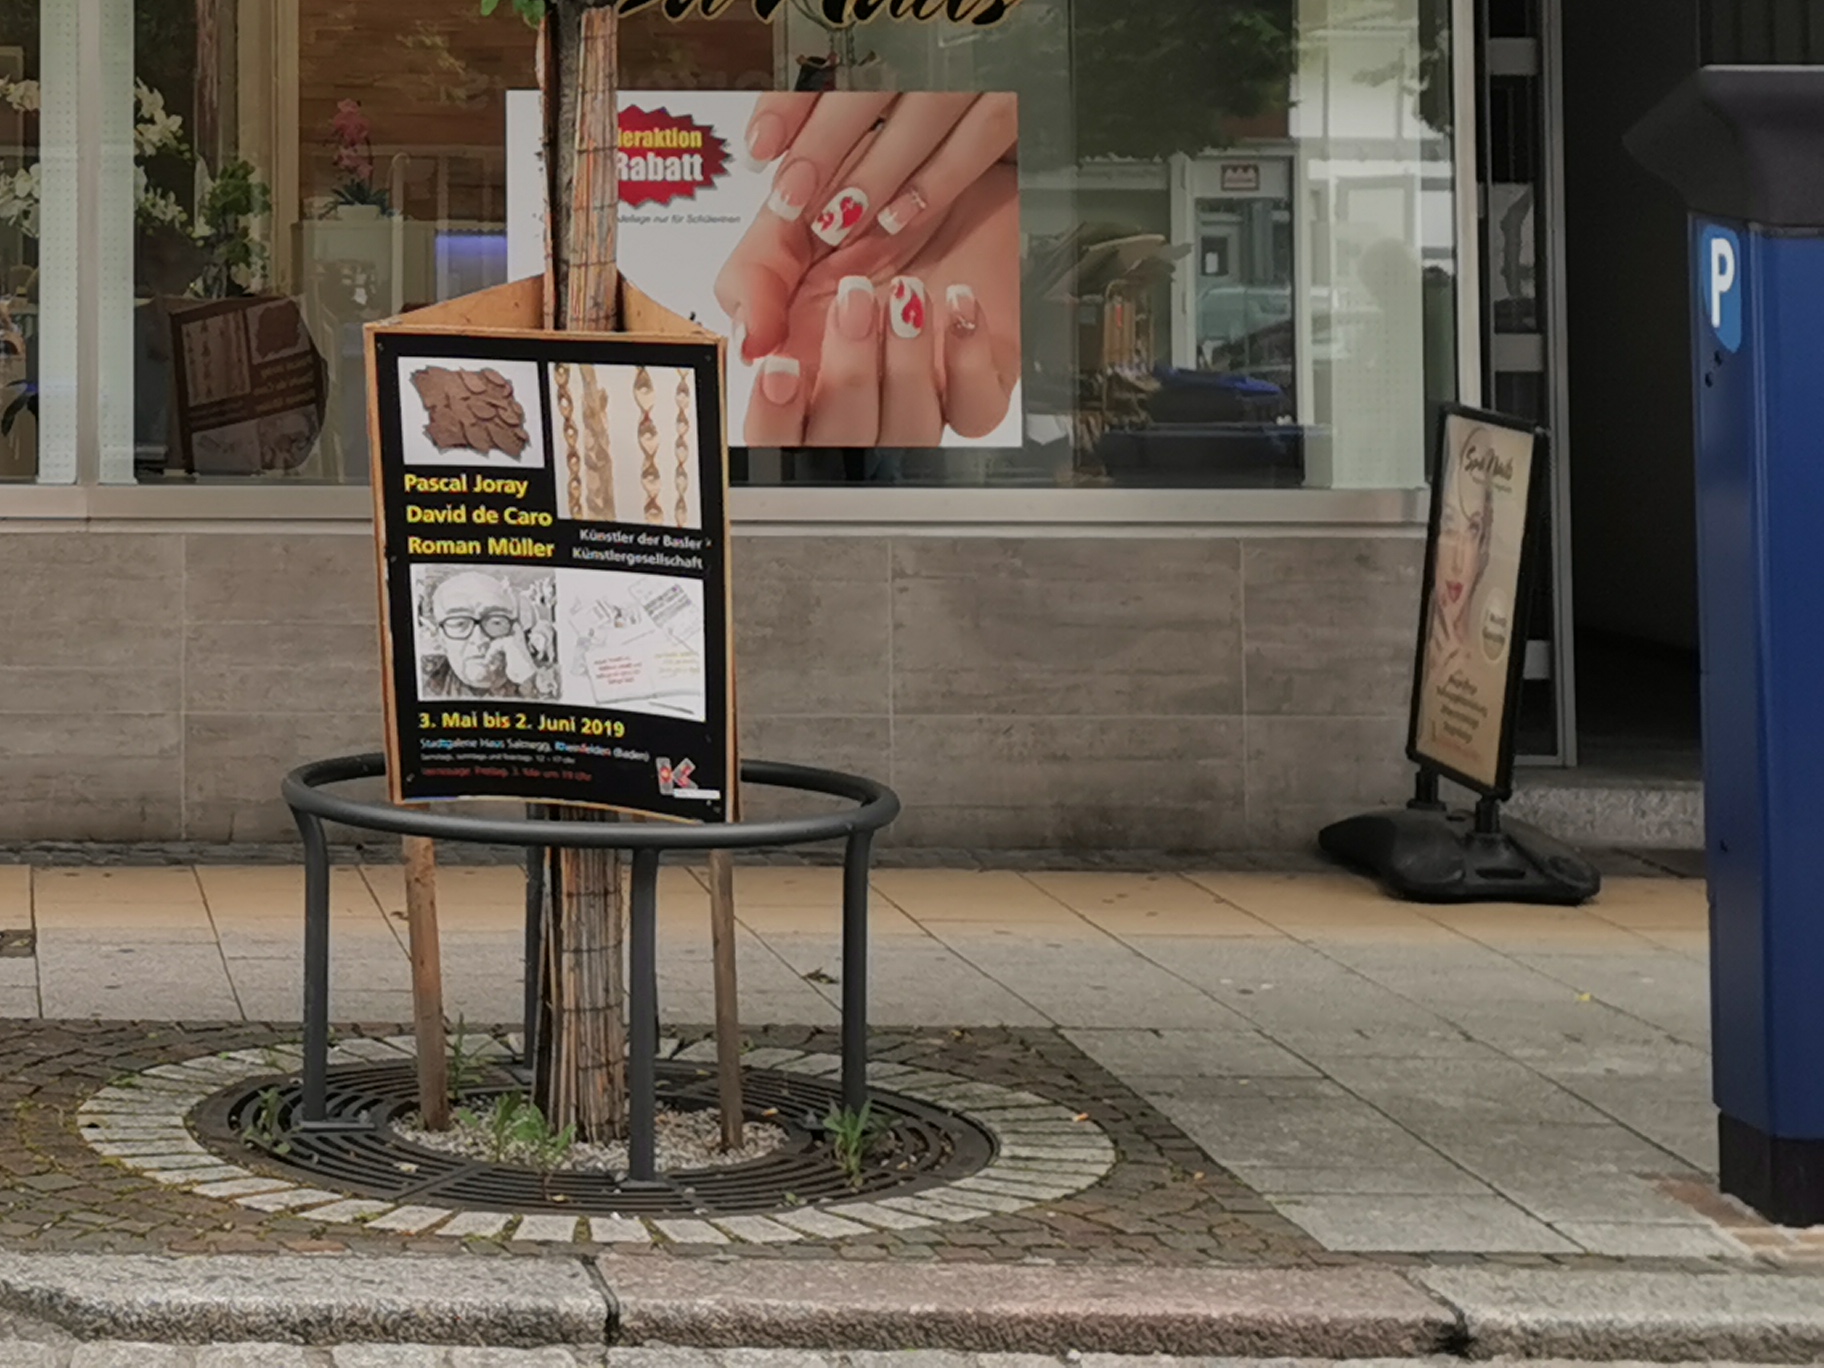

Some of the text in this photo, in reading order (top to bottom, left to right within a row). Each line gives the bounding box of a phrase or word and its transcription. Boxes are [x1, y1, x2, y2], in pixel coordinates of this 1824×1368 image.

[615, 151, 704, 181] Rabatt
[1711, 238, 1735, 328] P
[404, 473, 529, 499] Pascal Joray
[406, 503, 553, 527] David de Caro
[408, 536, 555, 557] Roman Müller
[579, 529, 702, 550] Künstler der Basler
[572, 546, 704, 570] Künstlergesellschaft
[418, 711, 625, 738] 3. Mai bis 2. Juni 2019
